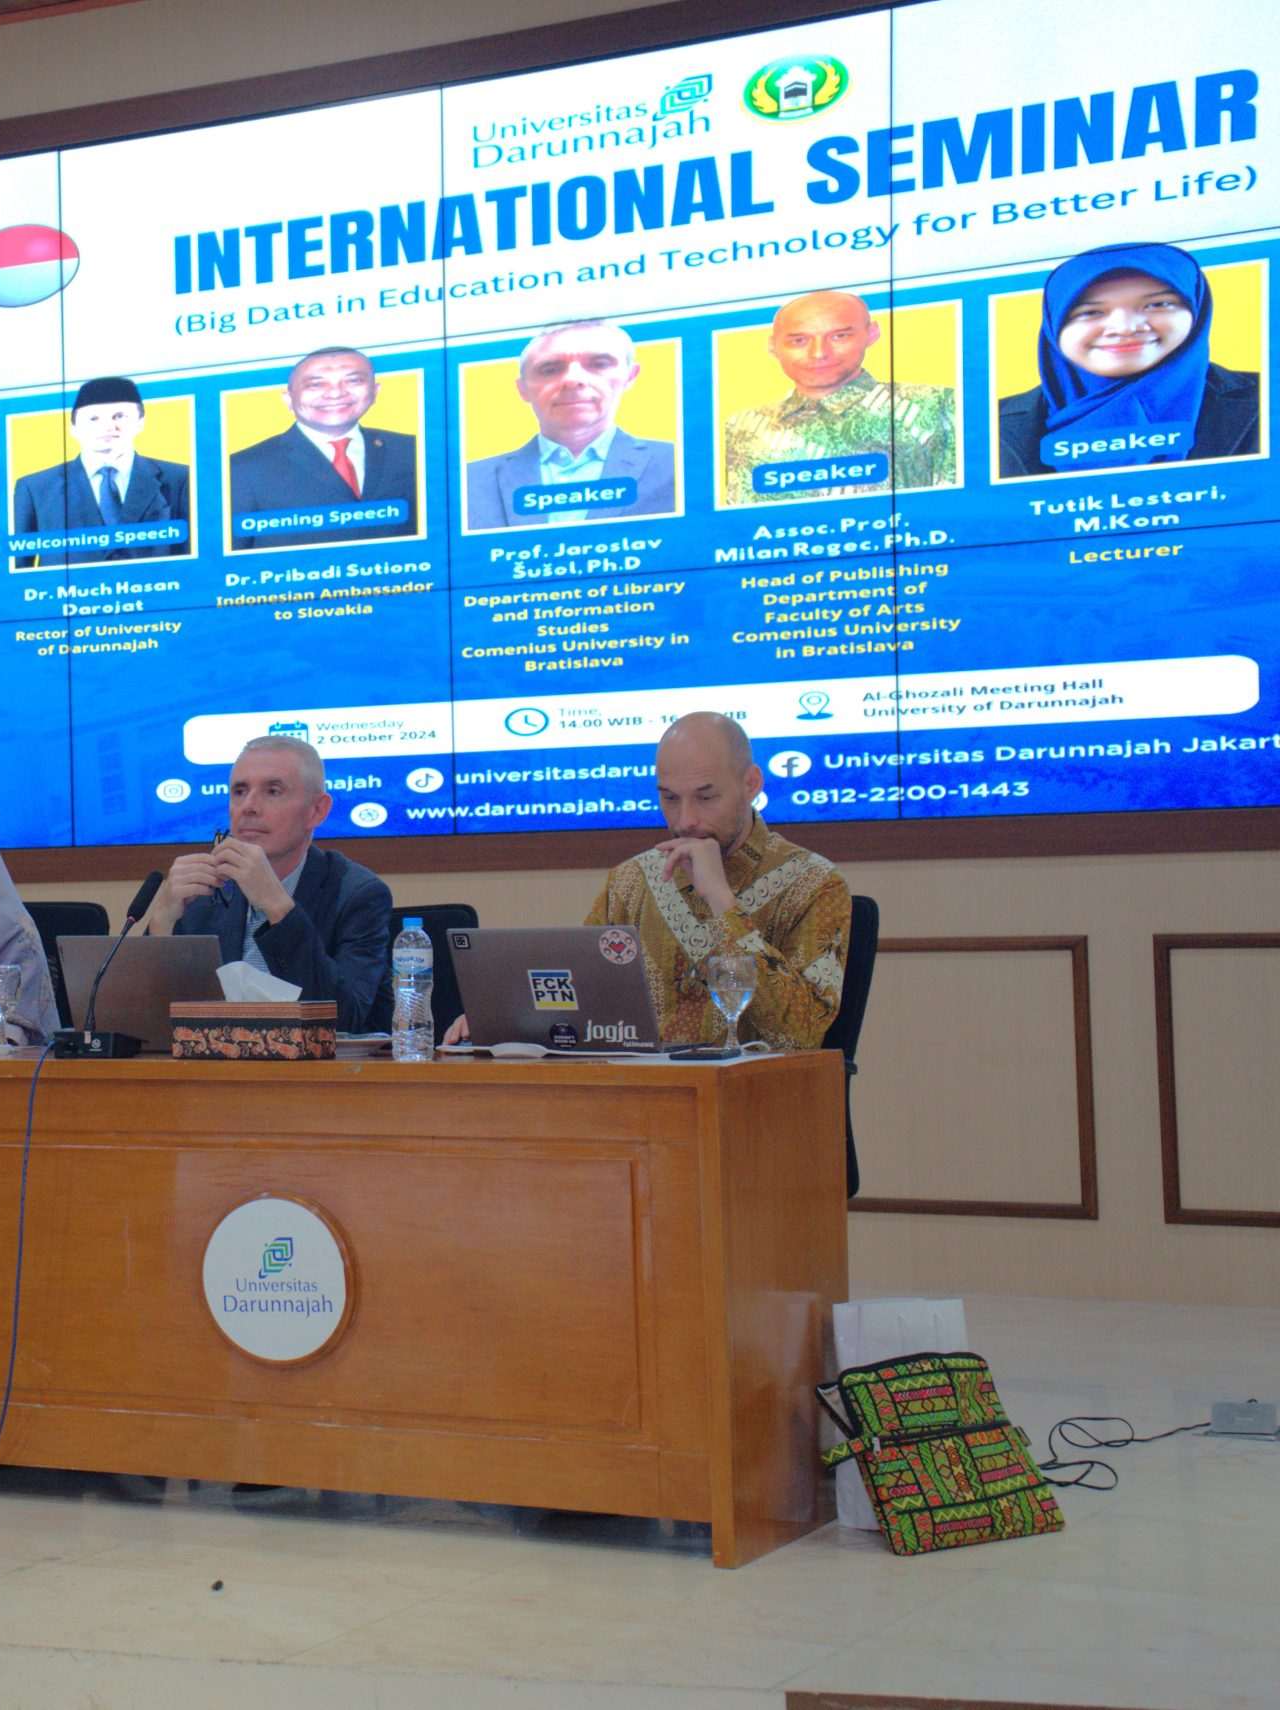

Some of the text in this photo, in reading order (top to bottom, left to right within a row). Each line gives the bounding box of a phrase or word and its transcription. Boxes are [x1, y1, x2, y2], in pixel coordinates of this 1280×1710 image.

[471, 98, 648, 144] Universitas
[472, 110, 711, 169] Darunnajah
[173, 68, 1260, 295] INTERNATIONAL SEMINAR
[174, 164, 1258, 336] (Big Data in Education and Technology for Better Life)
[1053, 431, 1182, 459] Speaker
[763, 461, 878, 488] Speaker
[523, 484, 627, 510] Speaker
[1029, 495, 1104, 516] Tutik
[241, 505, 400, 532] Opening Speech
[752, 512, 910, 541] Assoc. Prof.
[1073, 513, 1180, 533] M.Kom
[8, 526, 180, 552] Welcoming Speech
[490, 537, 663, 562] Prof. Jaroslav
[714, 546, 788, 563] Milan
[883, 530, 956, 549] Ph.D.
[586, 556, 641, 573] Ph.D
[1069, 543, 1184, 564] Lecturer
[225, 561, 432, 587] Dr. Pribadi Sutiono
[740, 563, 950, 589] Head of Publishing
[24, 580, 180, 602] Dr. Much Hasan
[215, 581, 434, 608] Indonesian Ambassador
[463, 580, 686, 608] Department of Library
[762, 581, 928, 607] Department of
[62, 600, 144, 617] Darojat
[274, 603, 373, 621] to Slovakia
[492, 600, 655, 623] and Information
[764, 602, 925, 624] Faculty of Arts
[15, 621, 182, 642] Rector of University
[536, 622, 610, 637] Studies
[731, 617, 962, 644] Comenius University
[37, 638, 159, 657] of Darunnajah
[461, 632, 690, 659] Comenius University in
[775, 638, 915, 659] in Bratislava
[524, 656, 624, 672] Bratislava
[862, 679, 1104, 702] Al-Ghozali Meeting Hall
[863, 693, 1125, 718] University of Darunnajah
[316, 719, 405, 731] Wednesday
[607, 716, 644, 726] WIB
[329, 732, 395, 744] October
[399, 729, 437, 741] 2024
[823, 733, 1280, 770] Universitas Darunnajah Jakart
[455, 764, 657, 785] universitasdaru
[791, 781, 1030, 806] 0812-2200-1443
[405, 798, 659, 820] www.darunnajah.ac.
[531, 977, 571, 990] FCK
[534, 990, 575, 1002] PTN
[234, 1277, 319, 1293] Universitas
[222, 1294, 334, 1319] Darunnajah
